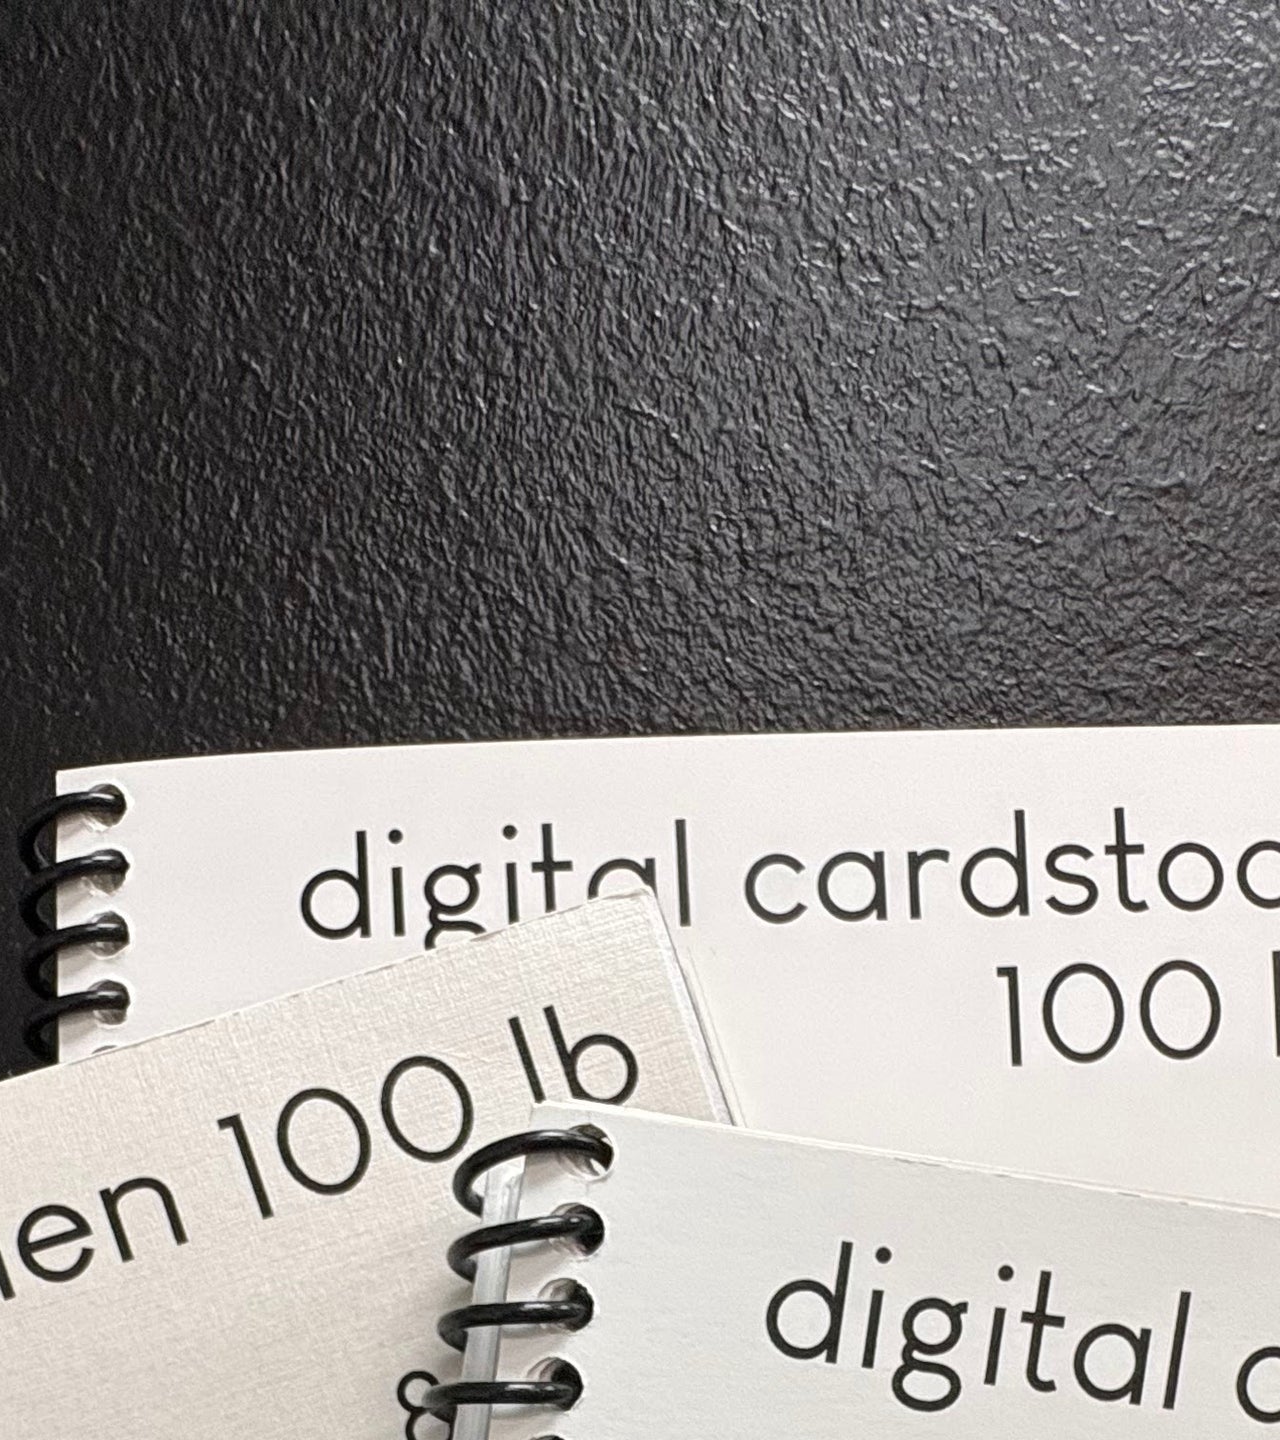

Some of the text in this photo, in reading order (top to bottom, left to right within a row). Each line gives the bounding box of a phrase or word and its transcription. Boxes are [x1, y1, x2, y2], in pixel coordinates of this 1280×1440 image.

[300, 819, 690, 950] digital
[996, 959, 1225, 1068] 100
[217, 1055, 474, 1219] 100
[507, 1005, 639, 1105] lb
[765, 1241, 1192, 1413] digital
